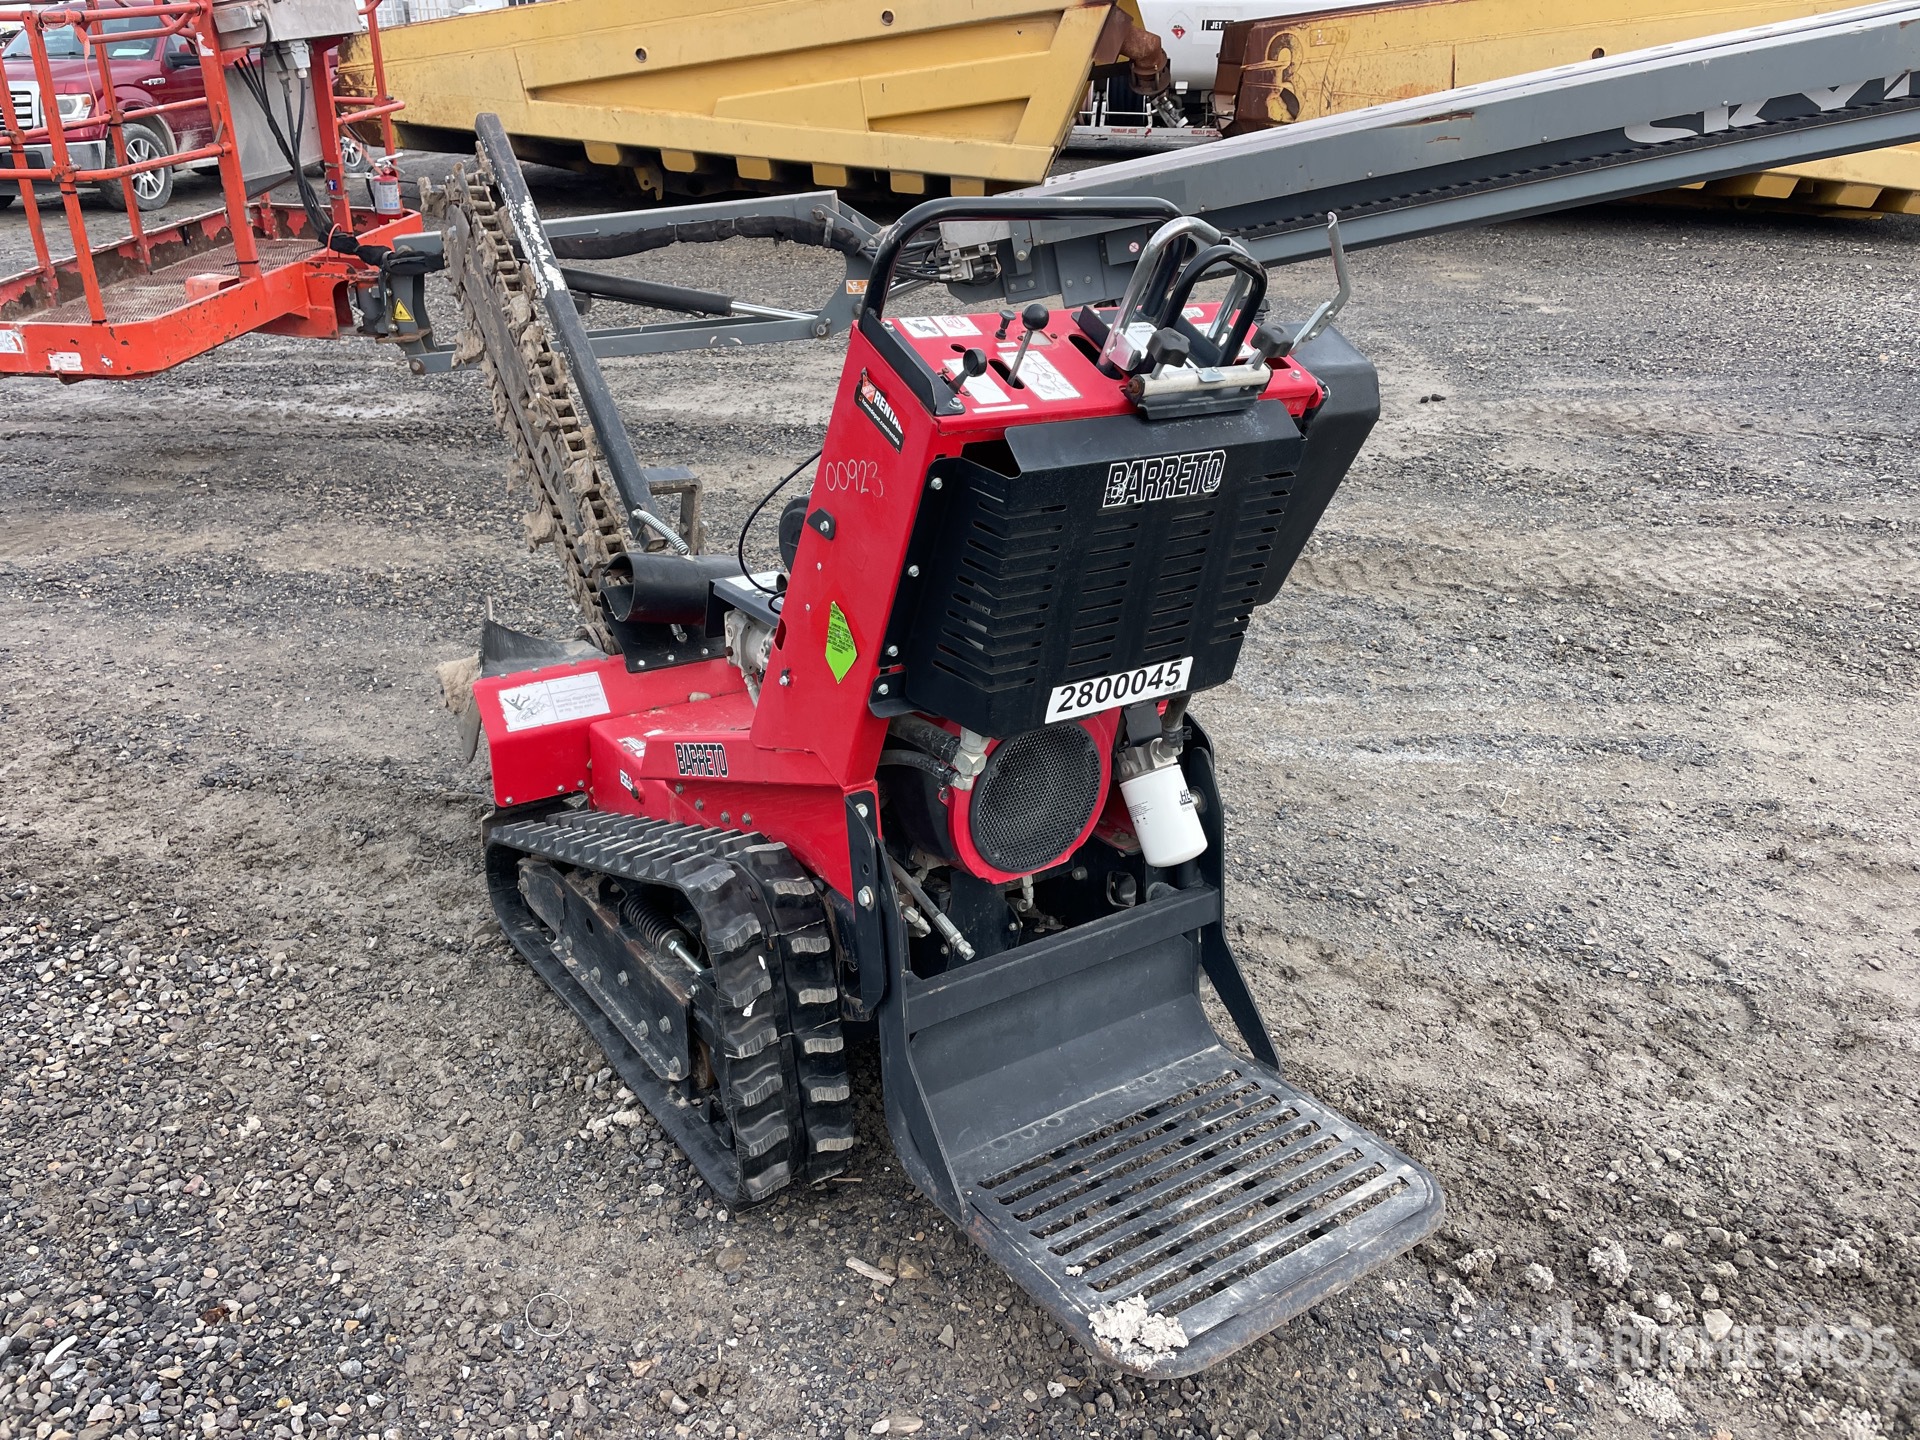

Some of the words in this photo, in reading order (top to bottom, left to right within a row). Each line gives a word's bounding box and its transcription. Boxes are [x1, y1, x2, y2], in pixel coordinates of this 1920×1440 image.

[1210, 21, 1223, 30] JET
[826, 459, 884, 498] 00923
[1102, 449, 1226, 508] BARRETO
[1056, 660, 1183, 714] 2800045
[674, 742, 729, 778] BARRETO
